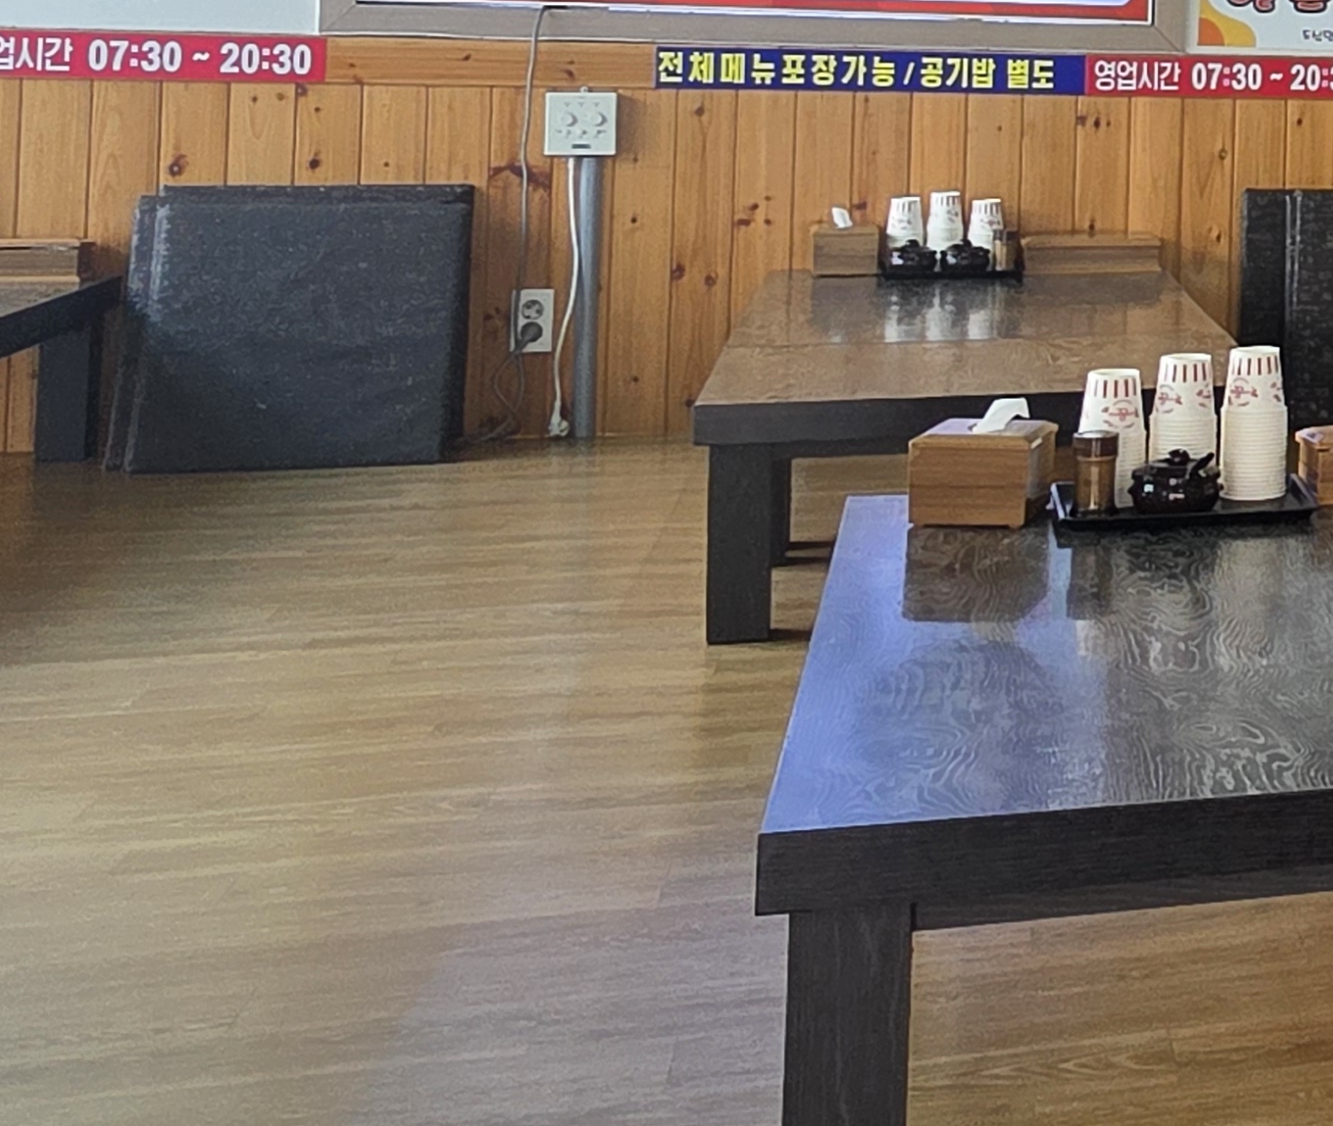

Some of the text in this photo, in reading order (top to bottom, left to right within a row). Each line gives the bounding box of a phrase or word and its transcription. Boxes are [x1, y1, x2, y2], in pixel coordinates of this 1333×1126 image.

[88, 39, 182, 72] 07:30
[219, 42, 312, 75] 20:30
[1006, 56, 1055, 90] 별도
[1094, 58, 1181, 93] 영업시간
[1191, 61, 1263, 92] 07:30
